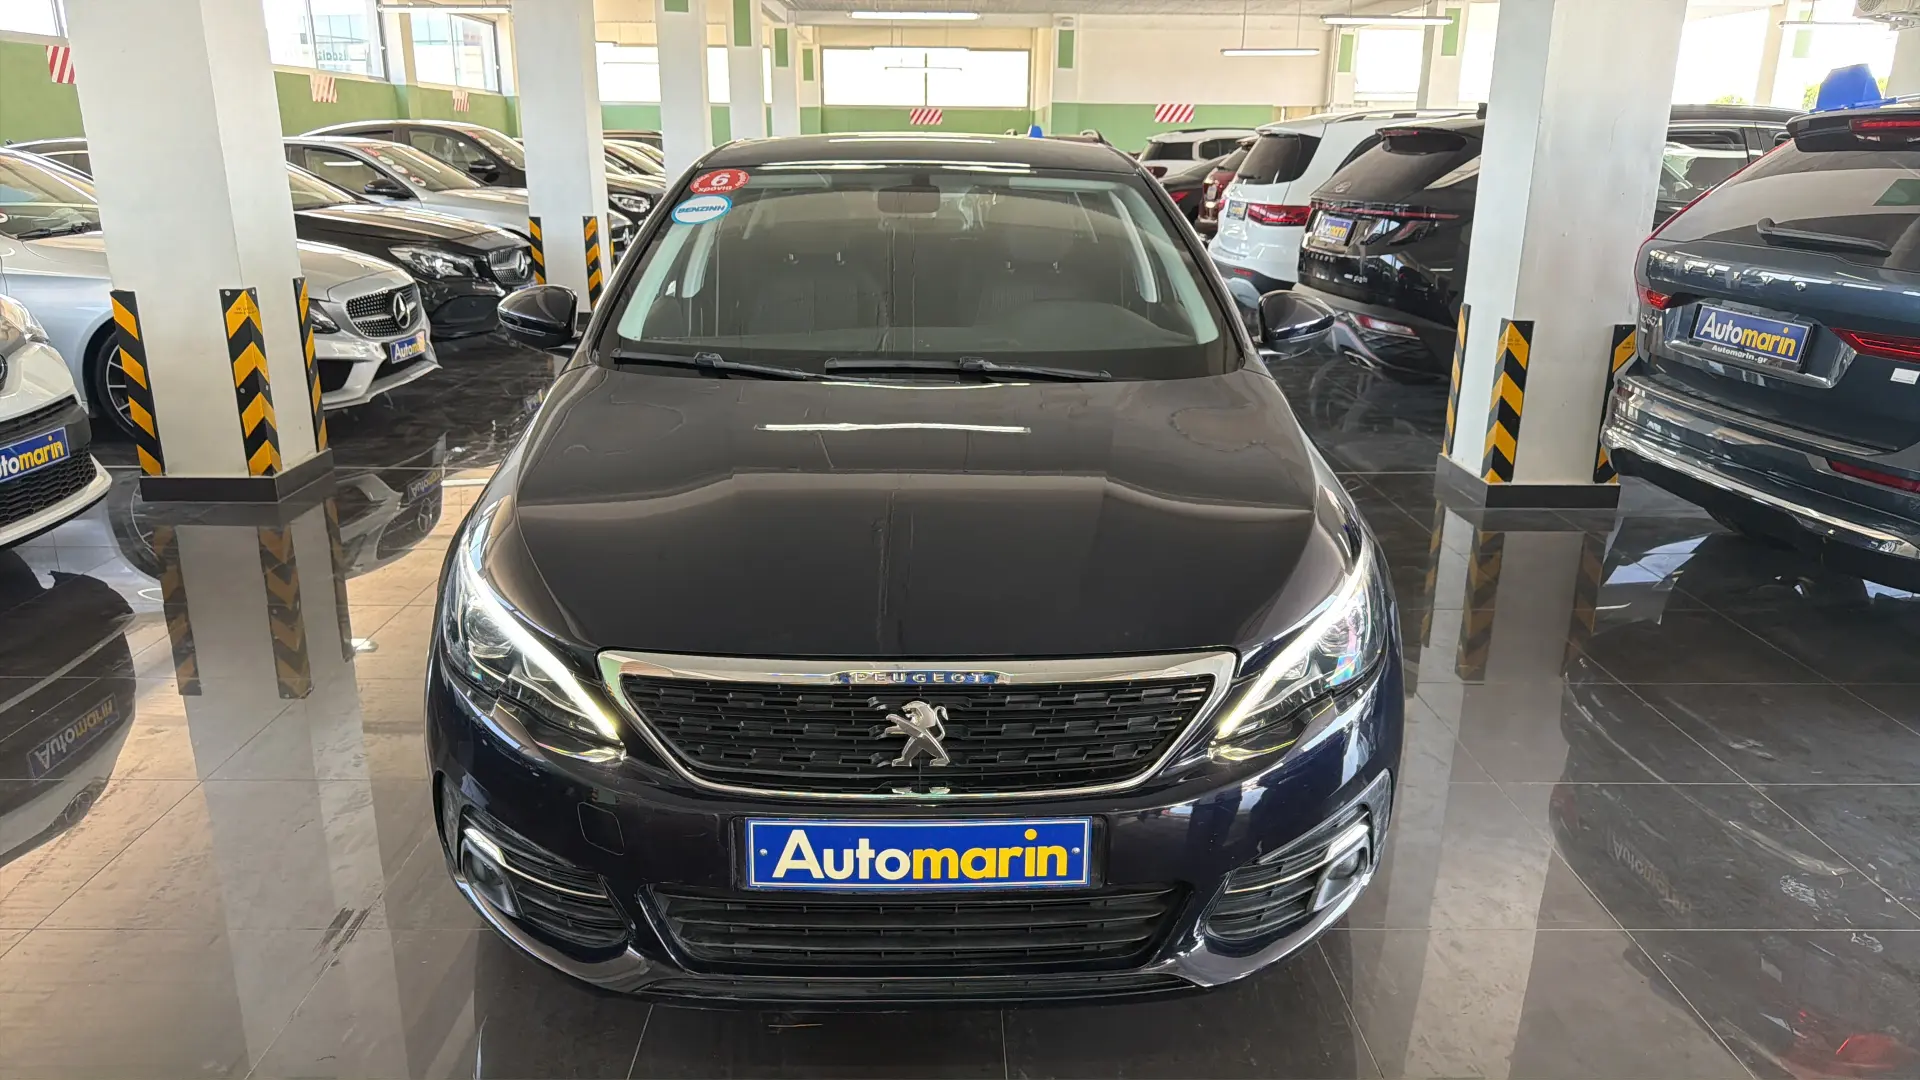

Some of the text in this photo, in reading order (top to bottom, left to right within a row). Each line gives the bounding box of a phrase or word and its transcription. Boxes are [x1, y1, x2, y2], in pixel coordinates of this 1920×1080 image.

[710, 173, 731, 187] 6
[1700, 311, 1797, 357] Automarin
[1711, 345, 1769, 364] Automarin.gr
[0, 435, 65, 478] tomarin
[855, 671, 984, 684] PEUGEOT
[770, 828, 1068, 880] Automarin
